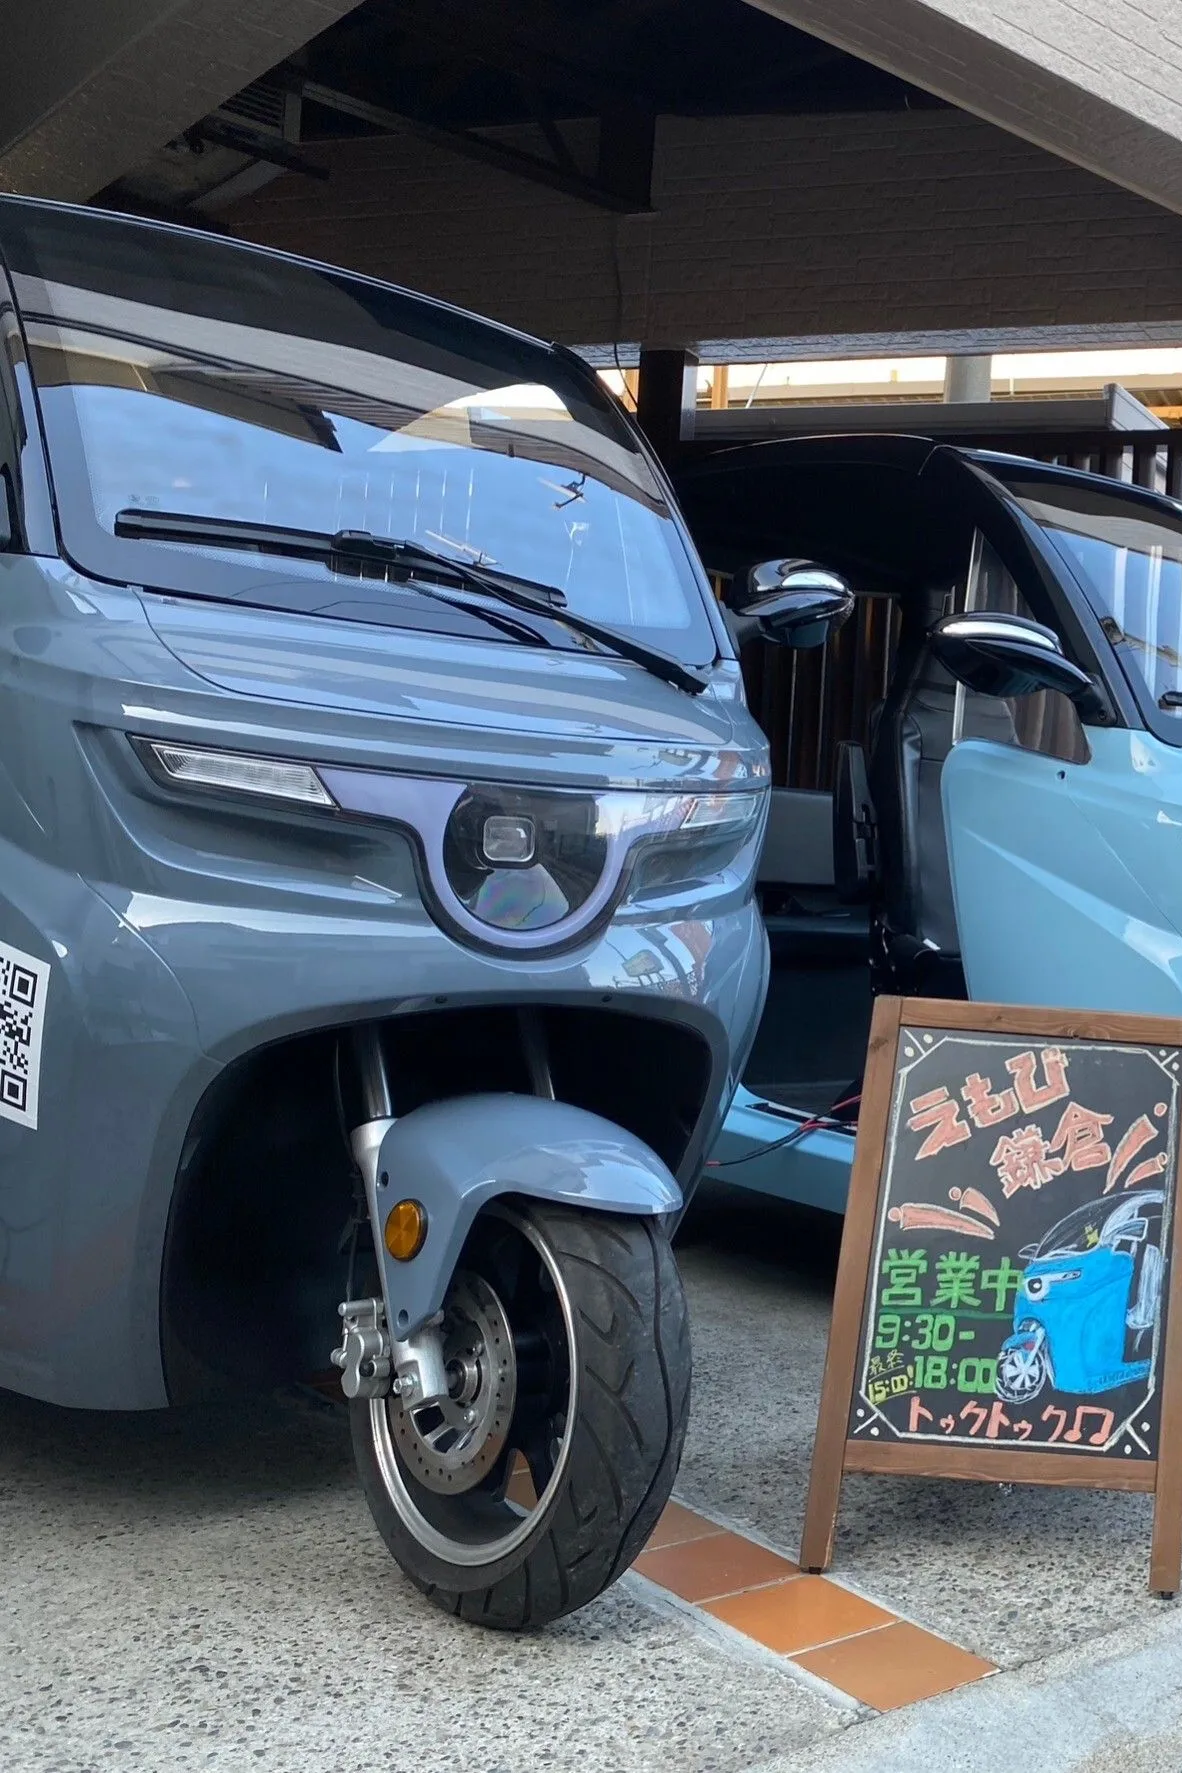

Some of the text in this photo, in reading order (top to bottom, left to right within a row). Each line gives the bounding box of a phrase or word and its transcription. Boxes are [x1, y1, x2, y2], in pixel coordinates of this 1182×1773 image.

[906, 1047, 1071, 1161] えもび
[989, 1101, 1114, 1198] 鎌倉
[881, 1248, 1023, 1312] 営業中
[868, 1349, 904, 1376] 最終
[868, 1364, 914, 1406] 15:00!
[914, 1355, 998, 1394] 18:00
[909, 1396, 1067, 1443] トゥクトゥク
